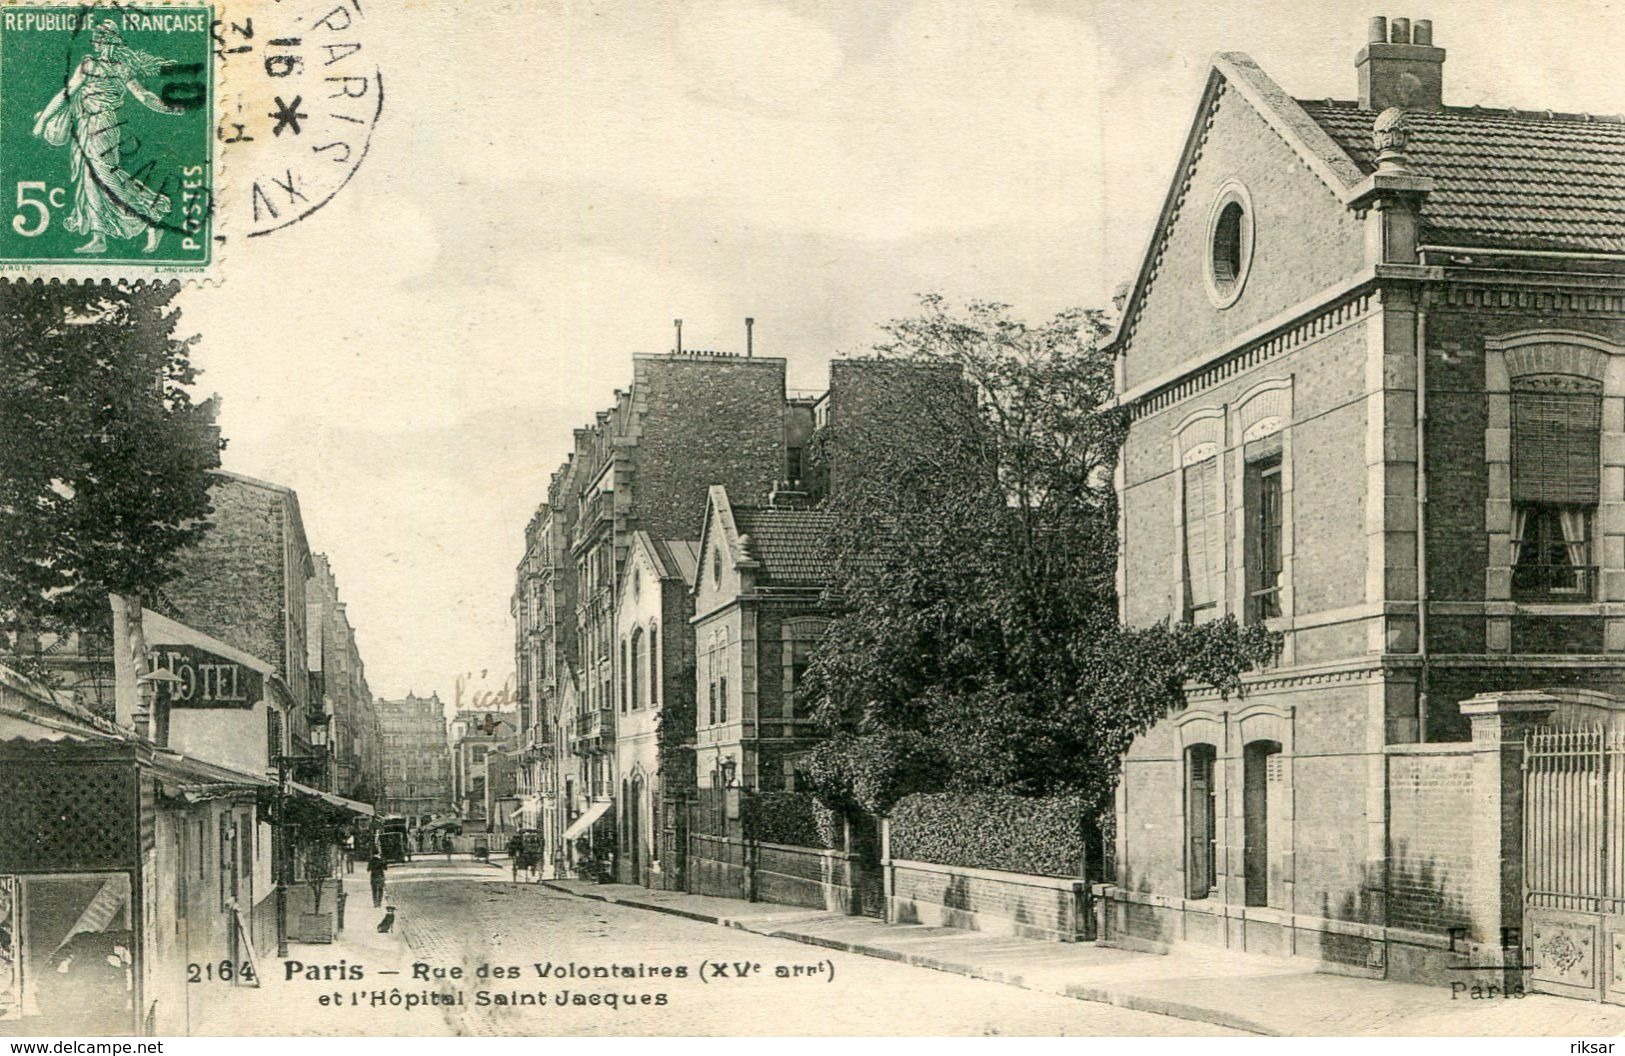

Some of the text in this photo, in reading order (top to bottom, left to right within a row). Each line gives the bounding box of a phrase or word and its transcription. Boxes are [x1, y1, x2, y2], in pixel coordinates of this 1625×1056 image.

[122, 14, 205, 34] FRANÇAISE
[253, 5, 368, 223] PARIS XV
[182, 165, 202, 250] POSTES
